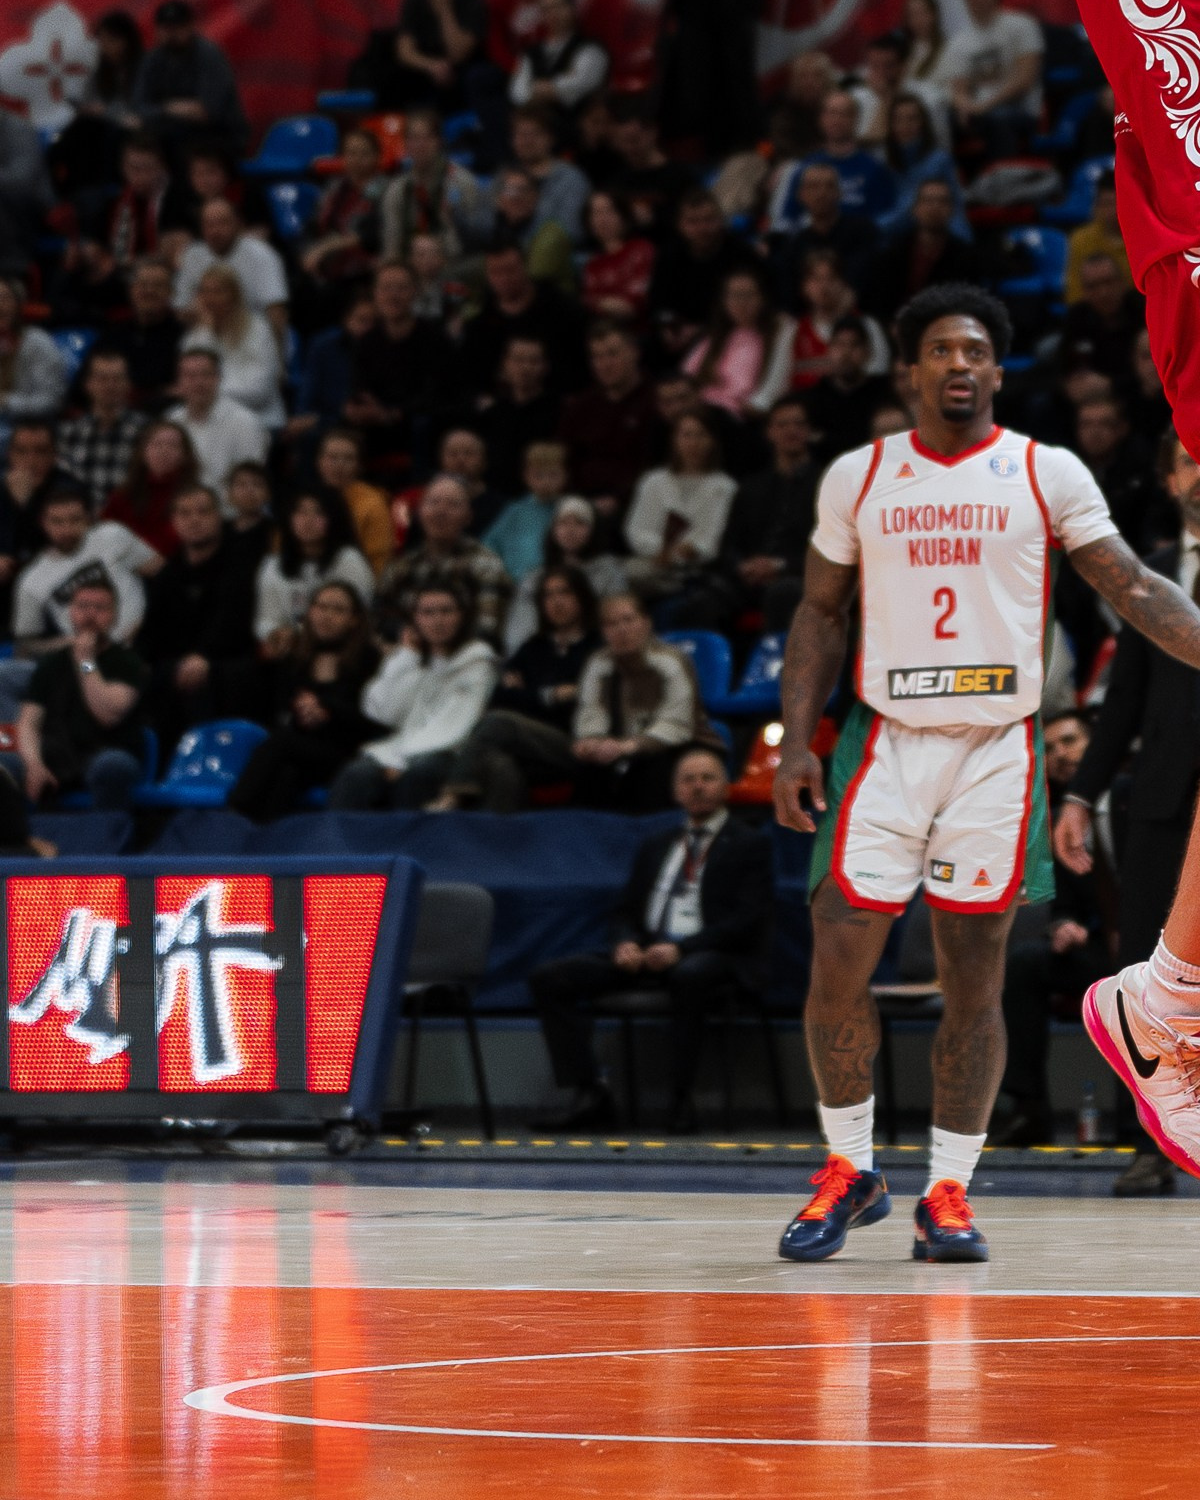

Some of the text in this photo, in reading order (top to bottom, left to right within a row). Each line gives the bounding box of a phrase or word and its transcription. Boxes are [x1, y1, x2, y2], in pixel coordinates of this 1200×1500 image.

[880, 503, 1011, 536] LOKOMOTIV
[907, 537, 983, 568] KUBAN
[932, 585, 959, 641] 2
[892, 667, 1015, 697] МЕЛБЕТ
